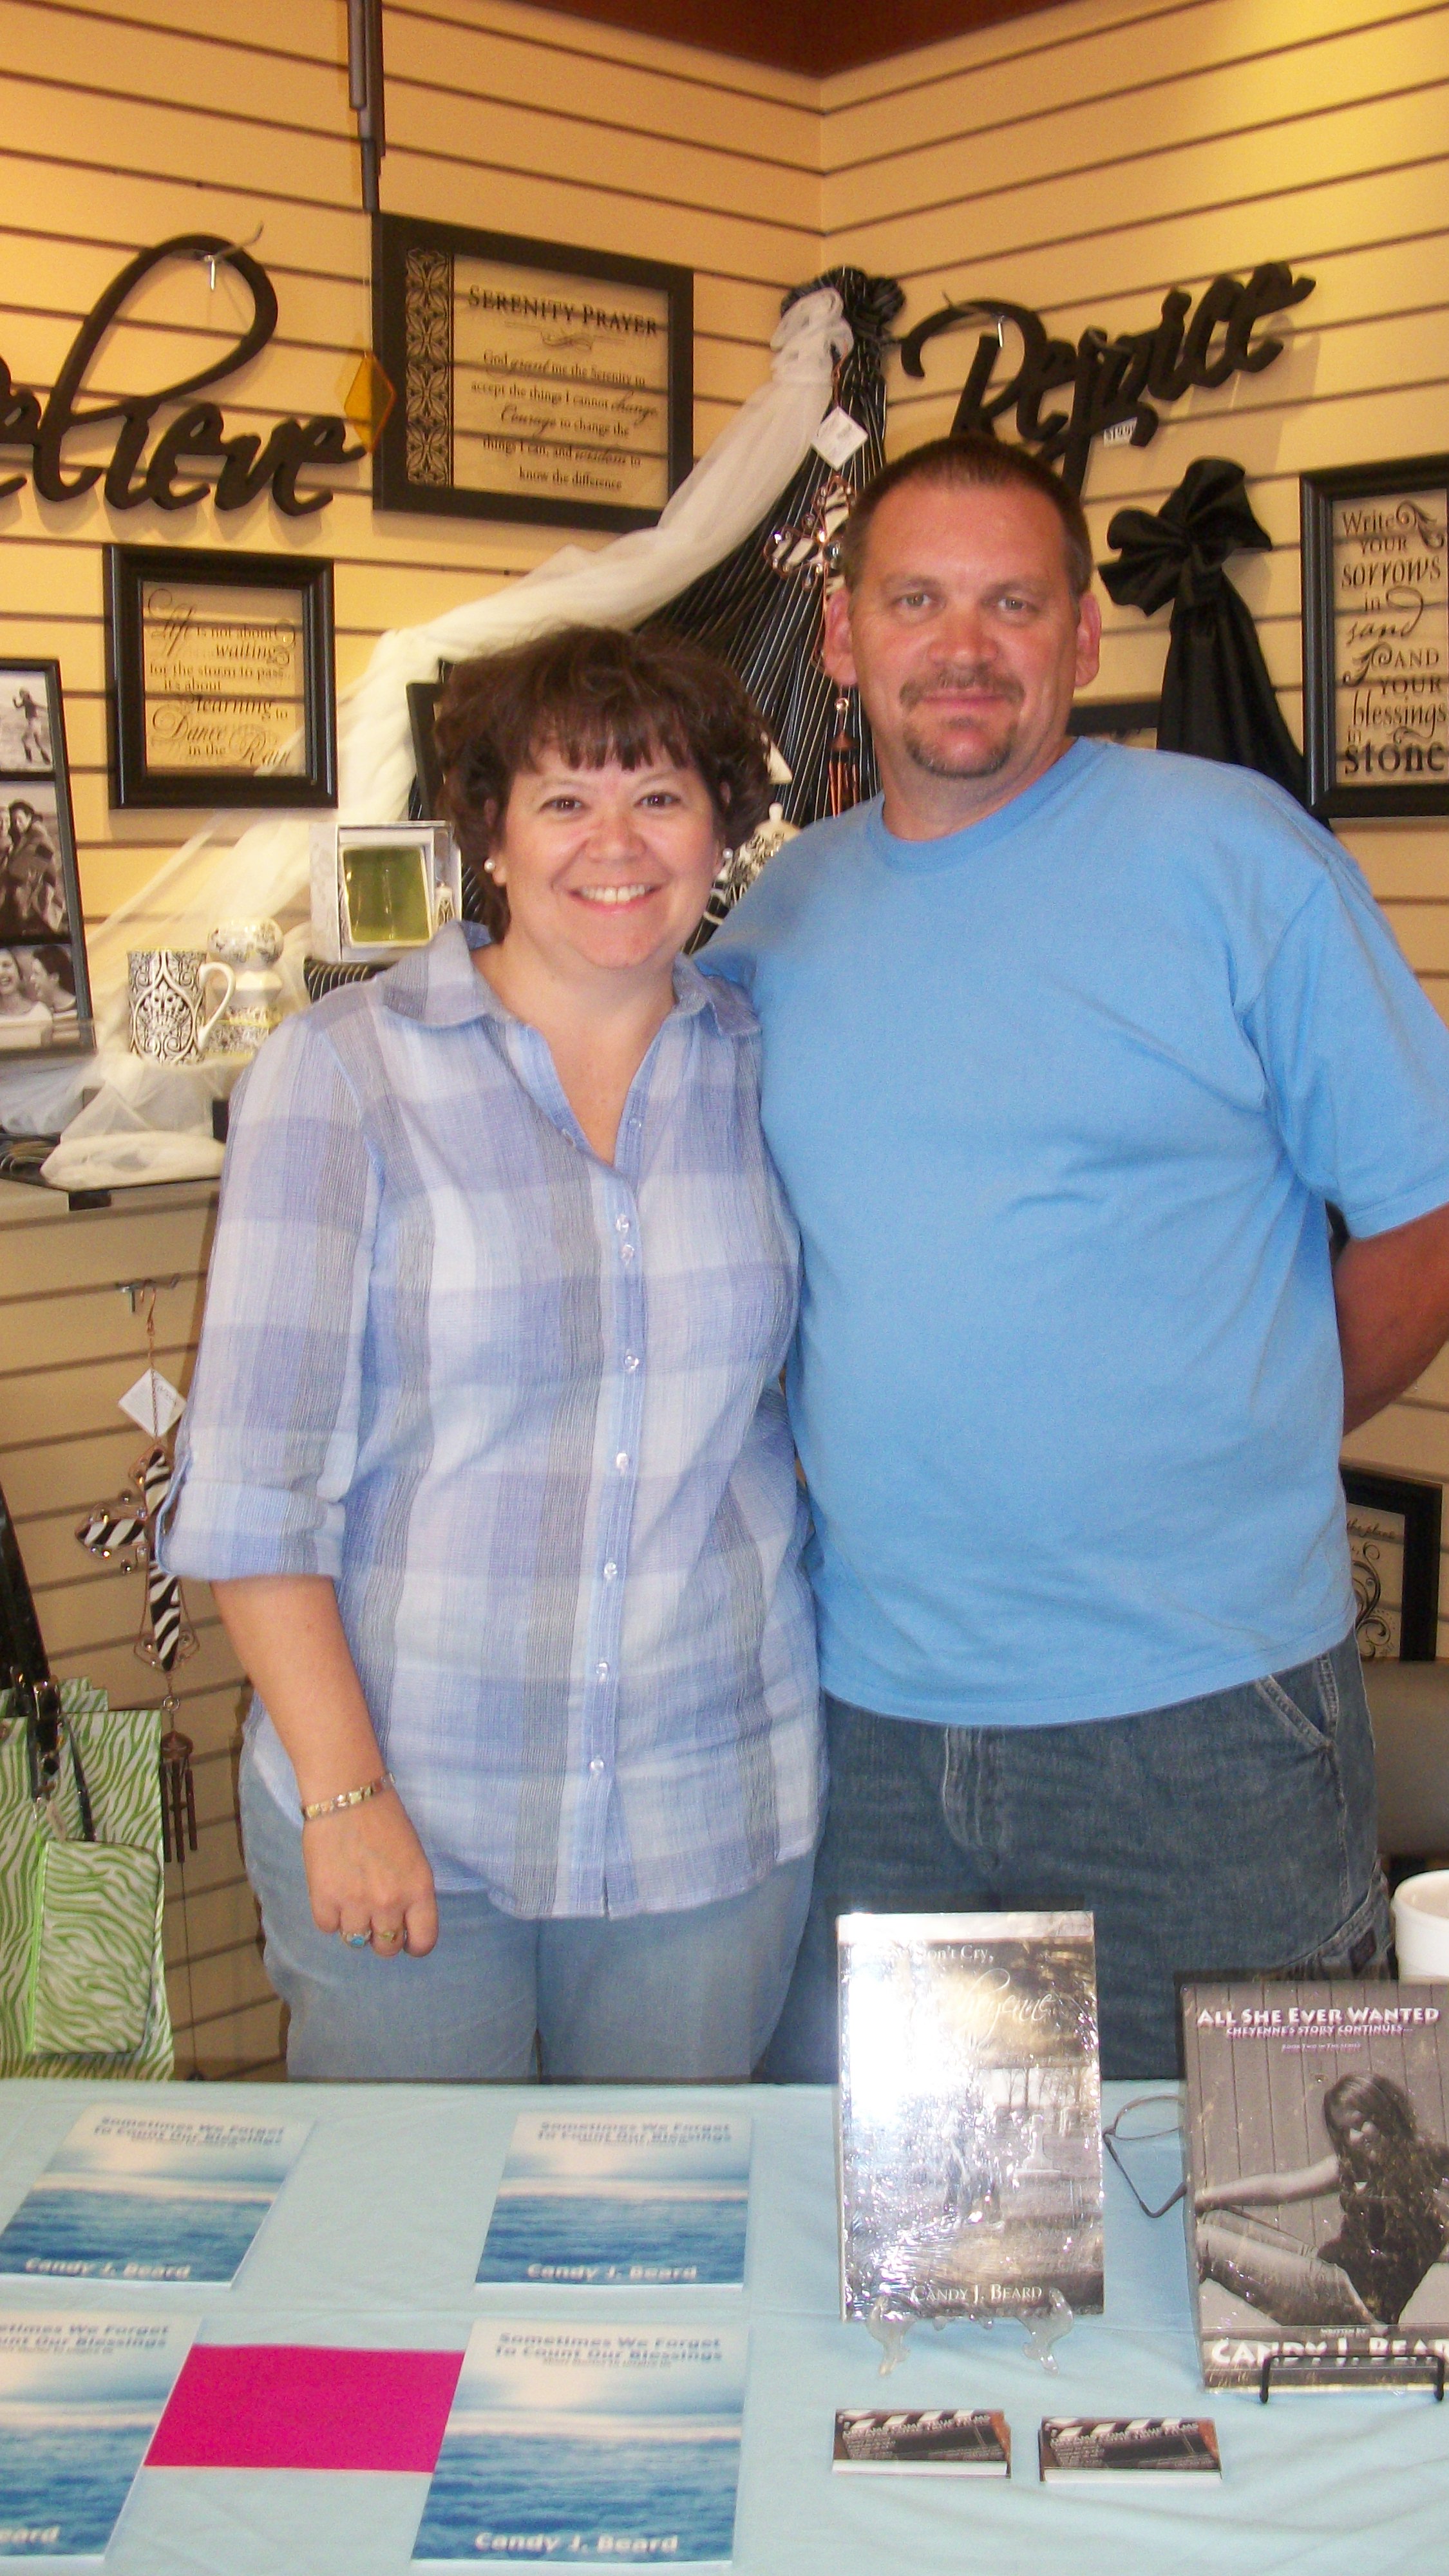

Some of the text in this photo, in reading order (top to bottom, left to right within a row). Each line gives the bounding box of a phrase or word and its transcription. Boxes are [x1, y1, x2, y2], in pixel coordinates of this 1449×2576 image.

[469, 283, 656, 336] SERENITY PRAYER
[0, 233, 366, 516] elieve
[483, 350, 507, 365] God
[571, 363, 588, 376] the
[591, 365, 632, 388] Serenity
[902, 261, 1316, 496] Rejoice
[471, 380, 505, 399] accept
[509, 384, 526, 396] the
[529, 384, 562, 405] things
[573, 395, 608, 409] cannot
[500, 404, 629, 438] Courage to change the
[482, 433, 516, 455] things
[554, 445, 573, 460] and
[630, 454, 641, 466] to
[519, 466, 622, 489] know the difference
[1342, 510, 1397, 537] Write
[1359, 535, 1408, 557] YOUR
[1342, 556, 1441, 588] sorrows
[1364, 592, 1381, 612] in
[1347, 585, 1425, 645] sand
[211, 627, 231, 638] not
[216, 643, 289, 665] waiting
[1395, 648, 1440, 668] AND
[150, 663, 167, 674] for
[173, 661, 193, 675] the
[198, 665, 236, 676] storm
[241, 666, 253, 676] to
[185, 677, 221, 692] about
[1379, 675, 1442, 696] YOUR
[196, 694, 288, 721] learning to
[1352, 690, 1448, 739] blessings
[152, 705, 225, 741] Dance
[1347, 724, 1361, 744] in
[188, 743, 226, 755] in the
[229, 726, 291, 766] Rain
[1344, 741, 1446, 775] stone
[960, 1944, 996, 1963] Cry,
[1197, 2006, 1441, 2027] ALL SHE EVER WANTED
[1297, 2025, 1335, 2036] STORY
[526, 2262, 598, 2282] Candy
[629, 2264, 698, 2281] Beard
[911, 2284, 1043, 2304] CANDY J. BEARD
[499, 2332, 721, 2350] Sometimes We Forget
[629, 2349, 723, 2362] Blessings
[474, 2532, 679, 2555] Candy J. Beard
